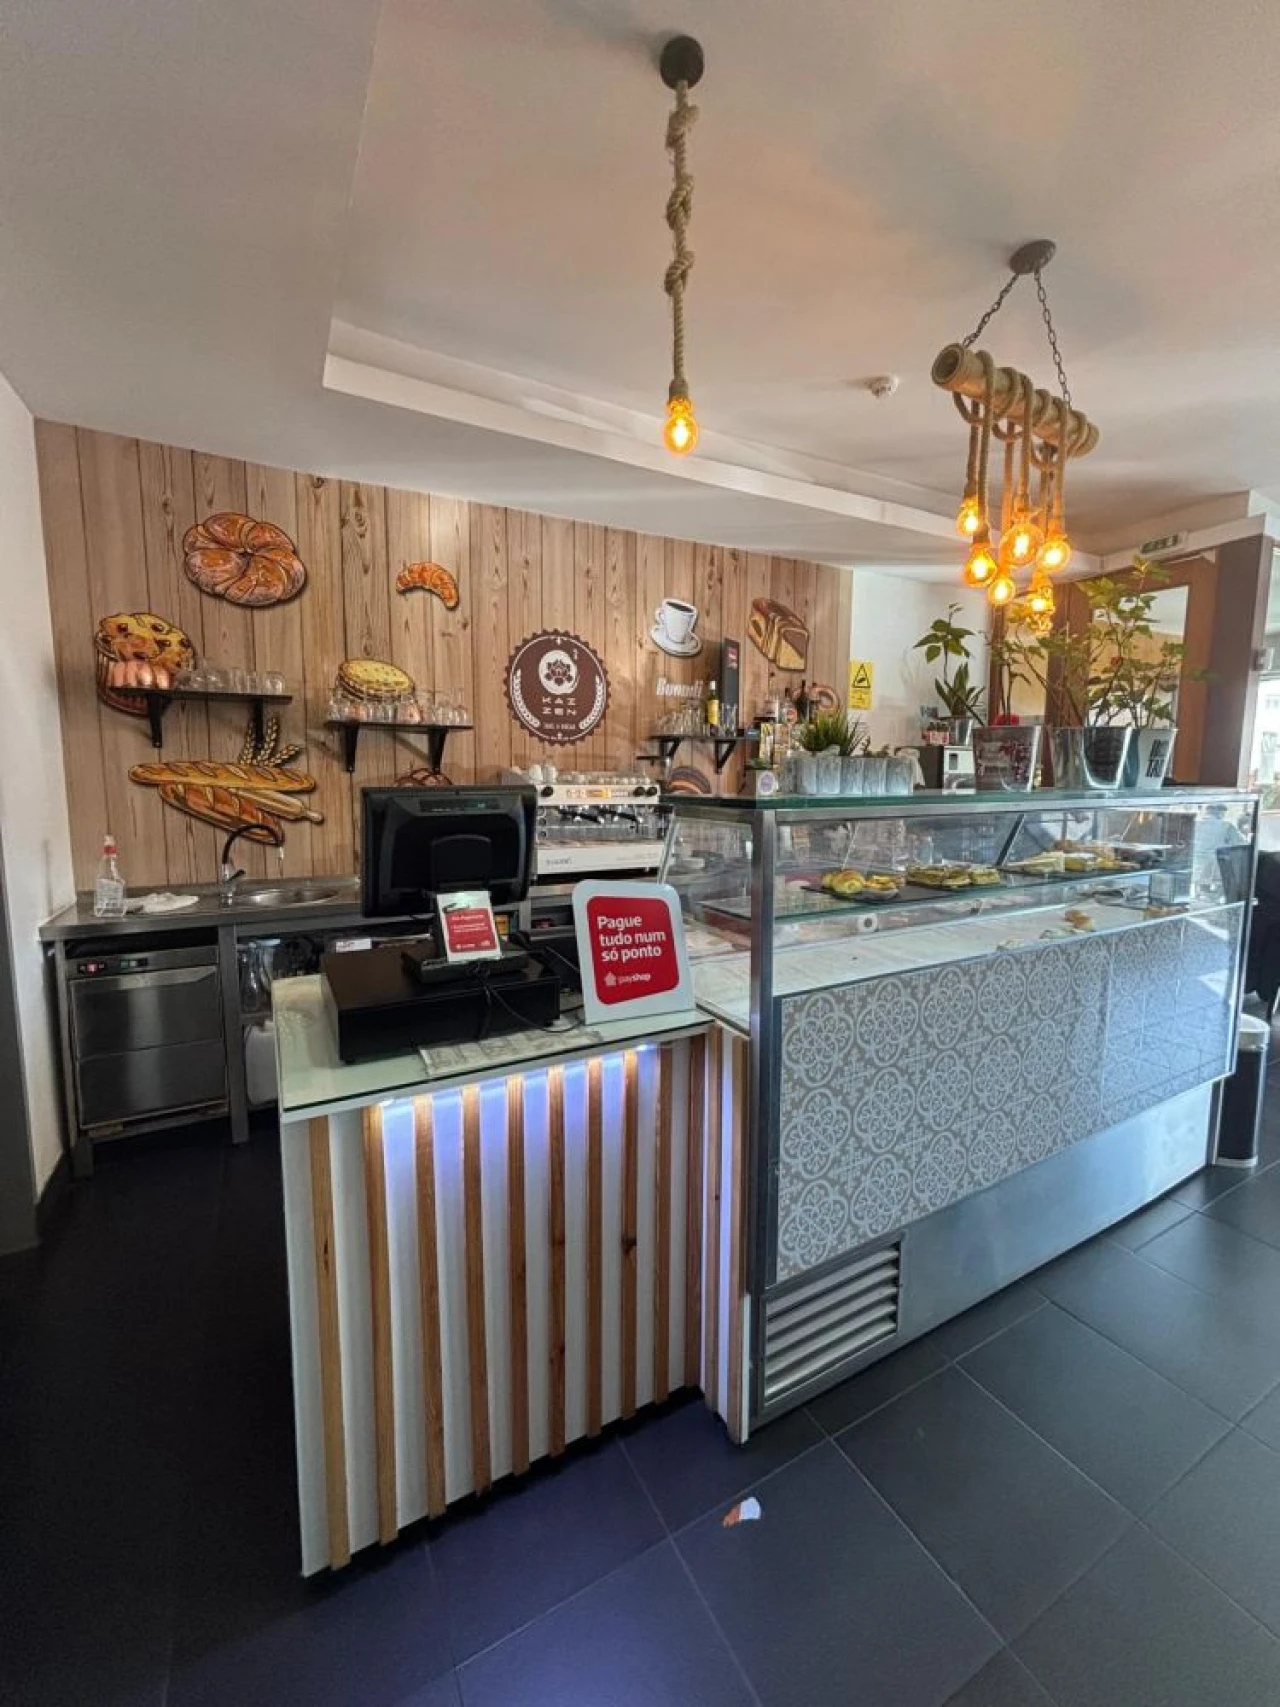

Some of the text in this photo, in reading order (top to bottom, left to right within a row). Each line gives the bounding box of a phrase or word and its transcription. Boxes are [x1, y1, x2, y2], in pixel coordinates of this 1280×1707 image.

[597, 916, 643, 931] Pague
[599, 931, 667, 947] tudo num
[601, 944, 662, 963] só ponto
[617, 972, 652, 984] payshop
